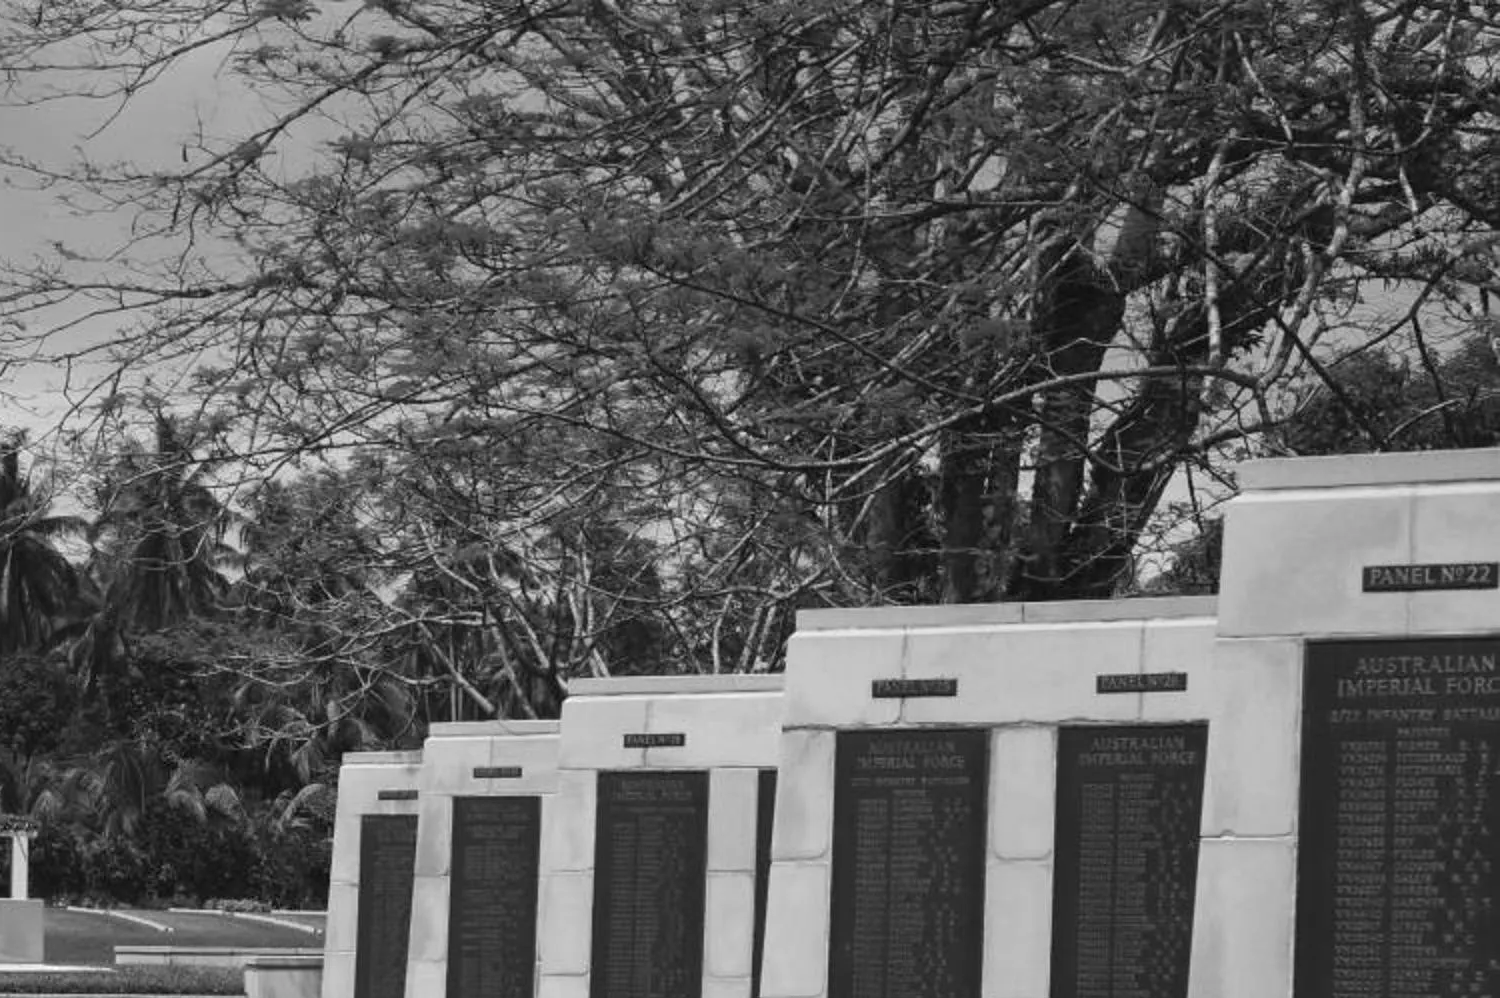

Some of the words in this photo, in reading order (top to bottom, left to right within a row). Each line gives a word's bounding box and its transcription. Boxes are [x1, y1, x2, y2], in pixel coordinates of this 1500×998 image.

[1370, 567, 1436, 586] PANEL
[1354, 655, 1496, 675] AUSTRALIAN
[1337, 677, 1437, 698] IMPERIAL
